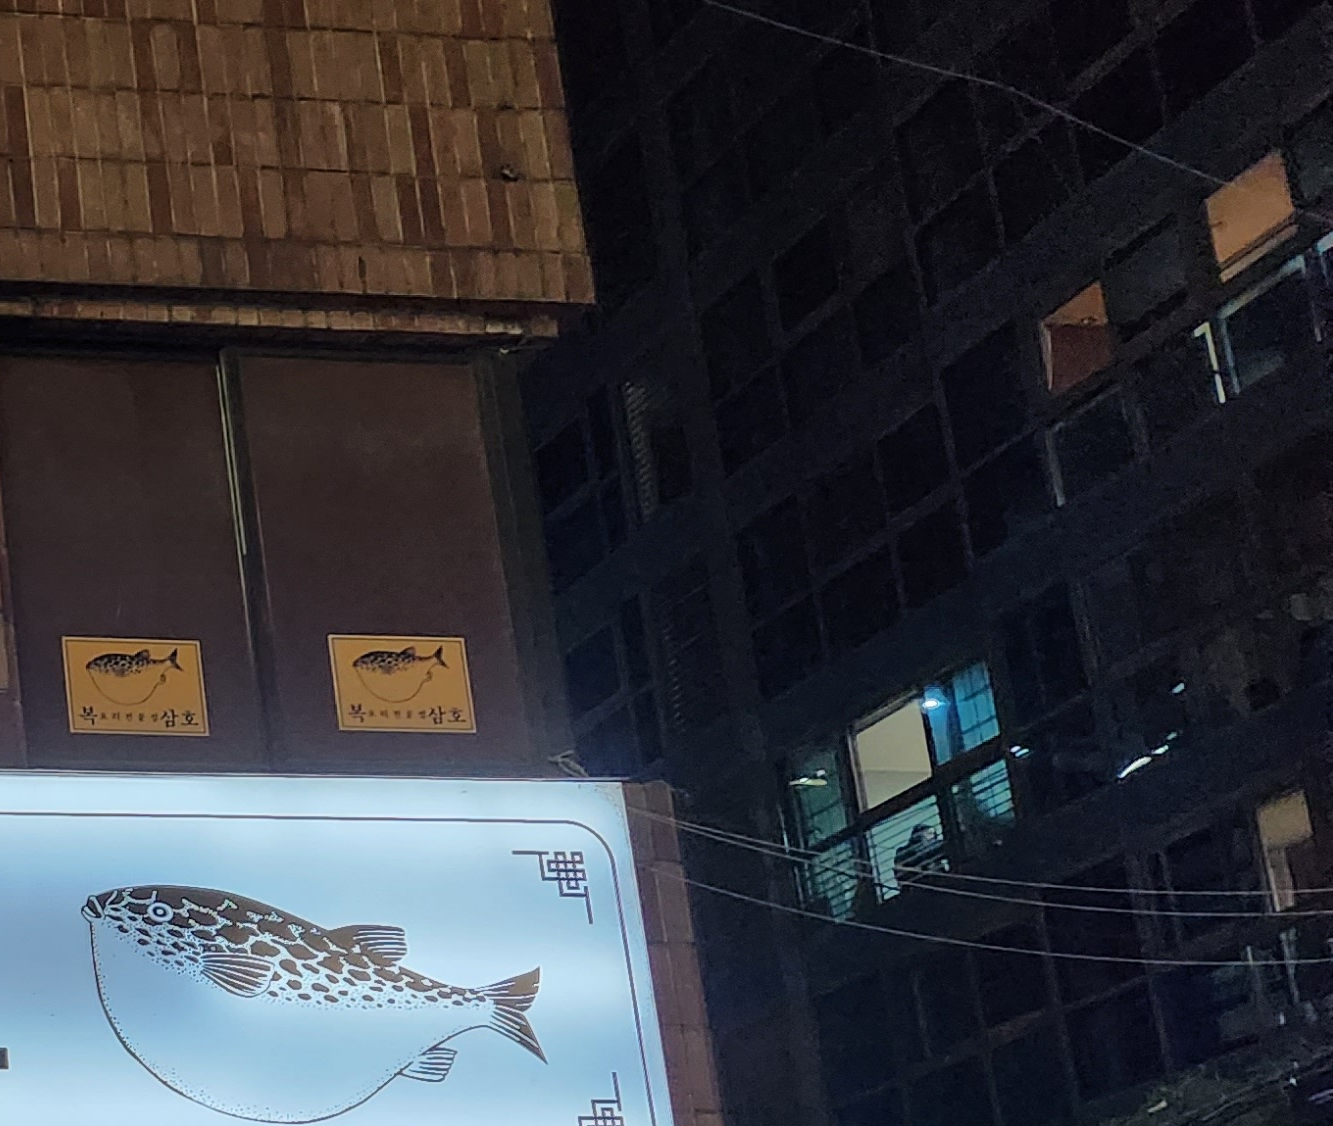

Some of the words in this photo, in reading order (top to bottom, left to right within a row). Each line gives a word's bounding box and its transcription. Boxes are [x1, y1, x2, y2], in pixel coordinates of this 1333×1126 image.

[78, 706, 98, 726] 복
[161, 708, 199, 728] 삼호
[348, 703, 366, 723] 복
[428, 705, 467, 725] 삼호
